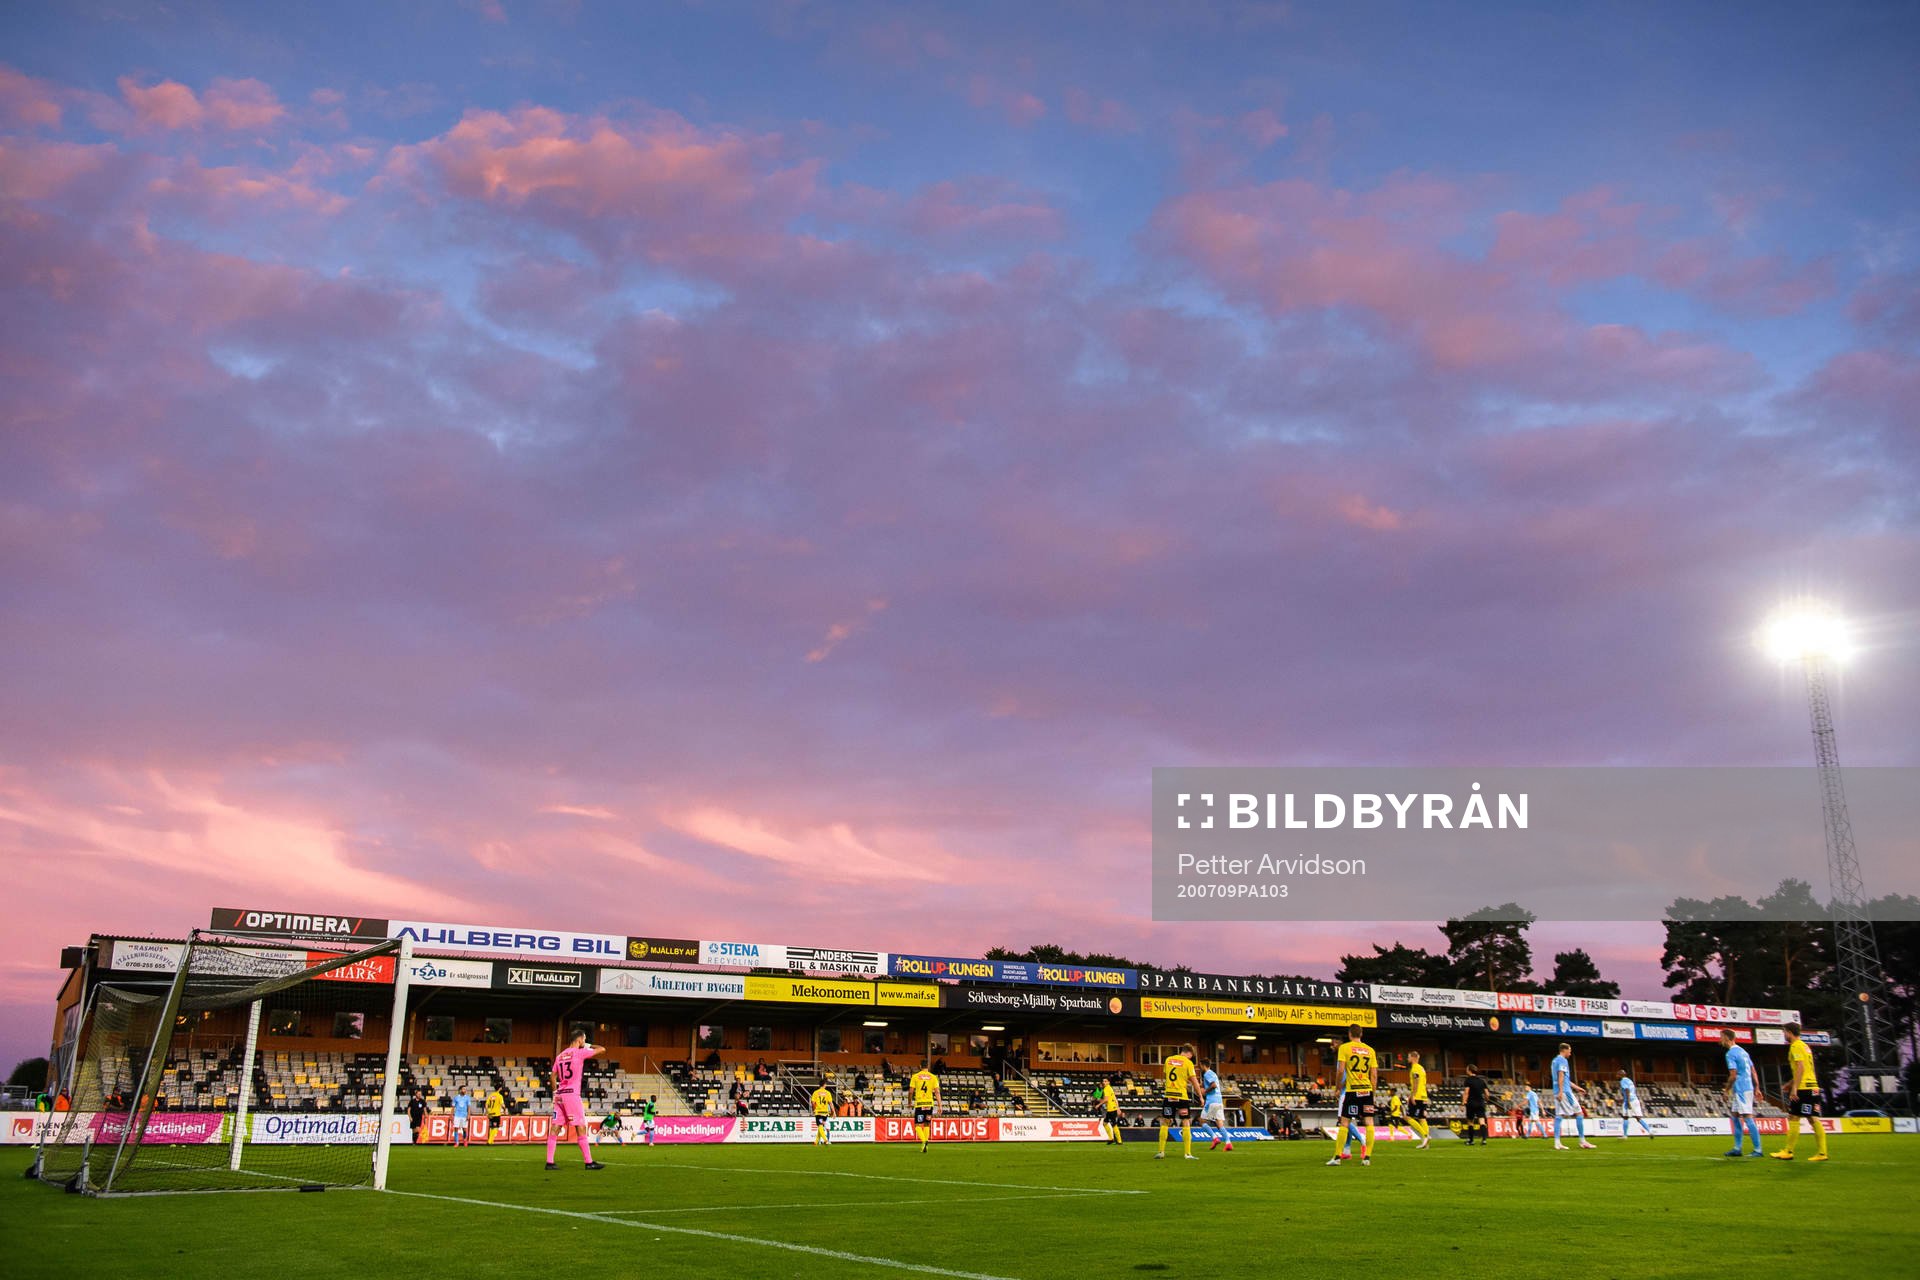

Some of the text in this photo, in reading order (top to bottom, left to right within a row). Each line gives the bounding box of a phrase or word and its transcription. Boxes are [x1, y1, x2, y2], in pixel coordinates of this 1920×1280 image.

[246, 912, 351, 933] OPTIMERA
[396, 927, 620, 954] AHLBERG BIL
[650, 946, 697, 956] MJÄLLBY AIF
[720, 943, 759, 956] STENA
[813, 950, 853, 962] ANDERS
[708, 956, 760, 966] RECYCLING
[789, 961, 806, 969] BIL
[819, 963, 860, 972] MASKIN
[863, 965, 876, 973] AB
[410, 967, 447, 977] TSAB
[535, 973, 576, 983] MJÄLLBY
[649, 975, 704, 992] JÄRLETOFT
[707, 983, 743, 993] BYGGER
[1141, 973, 1369, 999] SPARBANKSLÄKTAREN
[791, 984, 870, 999] Mekonomen
[880, 990, 936, 1000] www.maif.se
[968, 990, 1102, 1010] Sölvesborg-Mjällby Sparbank
[1499, 994, 1533, 1010] SAVE
[1554, 998, 1577, 1008] FASAB
[1587, 1000, 1608, 1010] FASAB
[1154, 1001, 1243, 1016] Sölvesborgs kommun
[1315, 1010, 1363, 1023] hemmaplan
[559, 1062, 573, 1080] 13
[1350, 1055, 1370, 1074] 23
[1169, 1067, 1178, 1082] 6
[921, 1081, 928, 1093] 4
[819, 1095, 826, 1105] 14
[674, 1124, 725, 1137] backlinjen!
[747, 1120, 796, 1132] PEAB
[830, 1120, 865, 1132] EAB
[888, 1119, 988, 1137] BAHAUS
